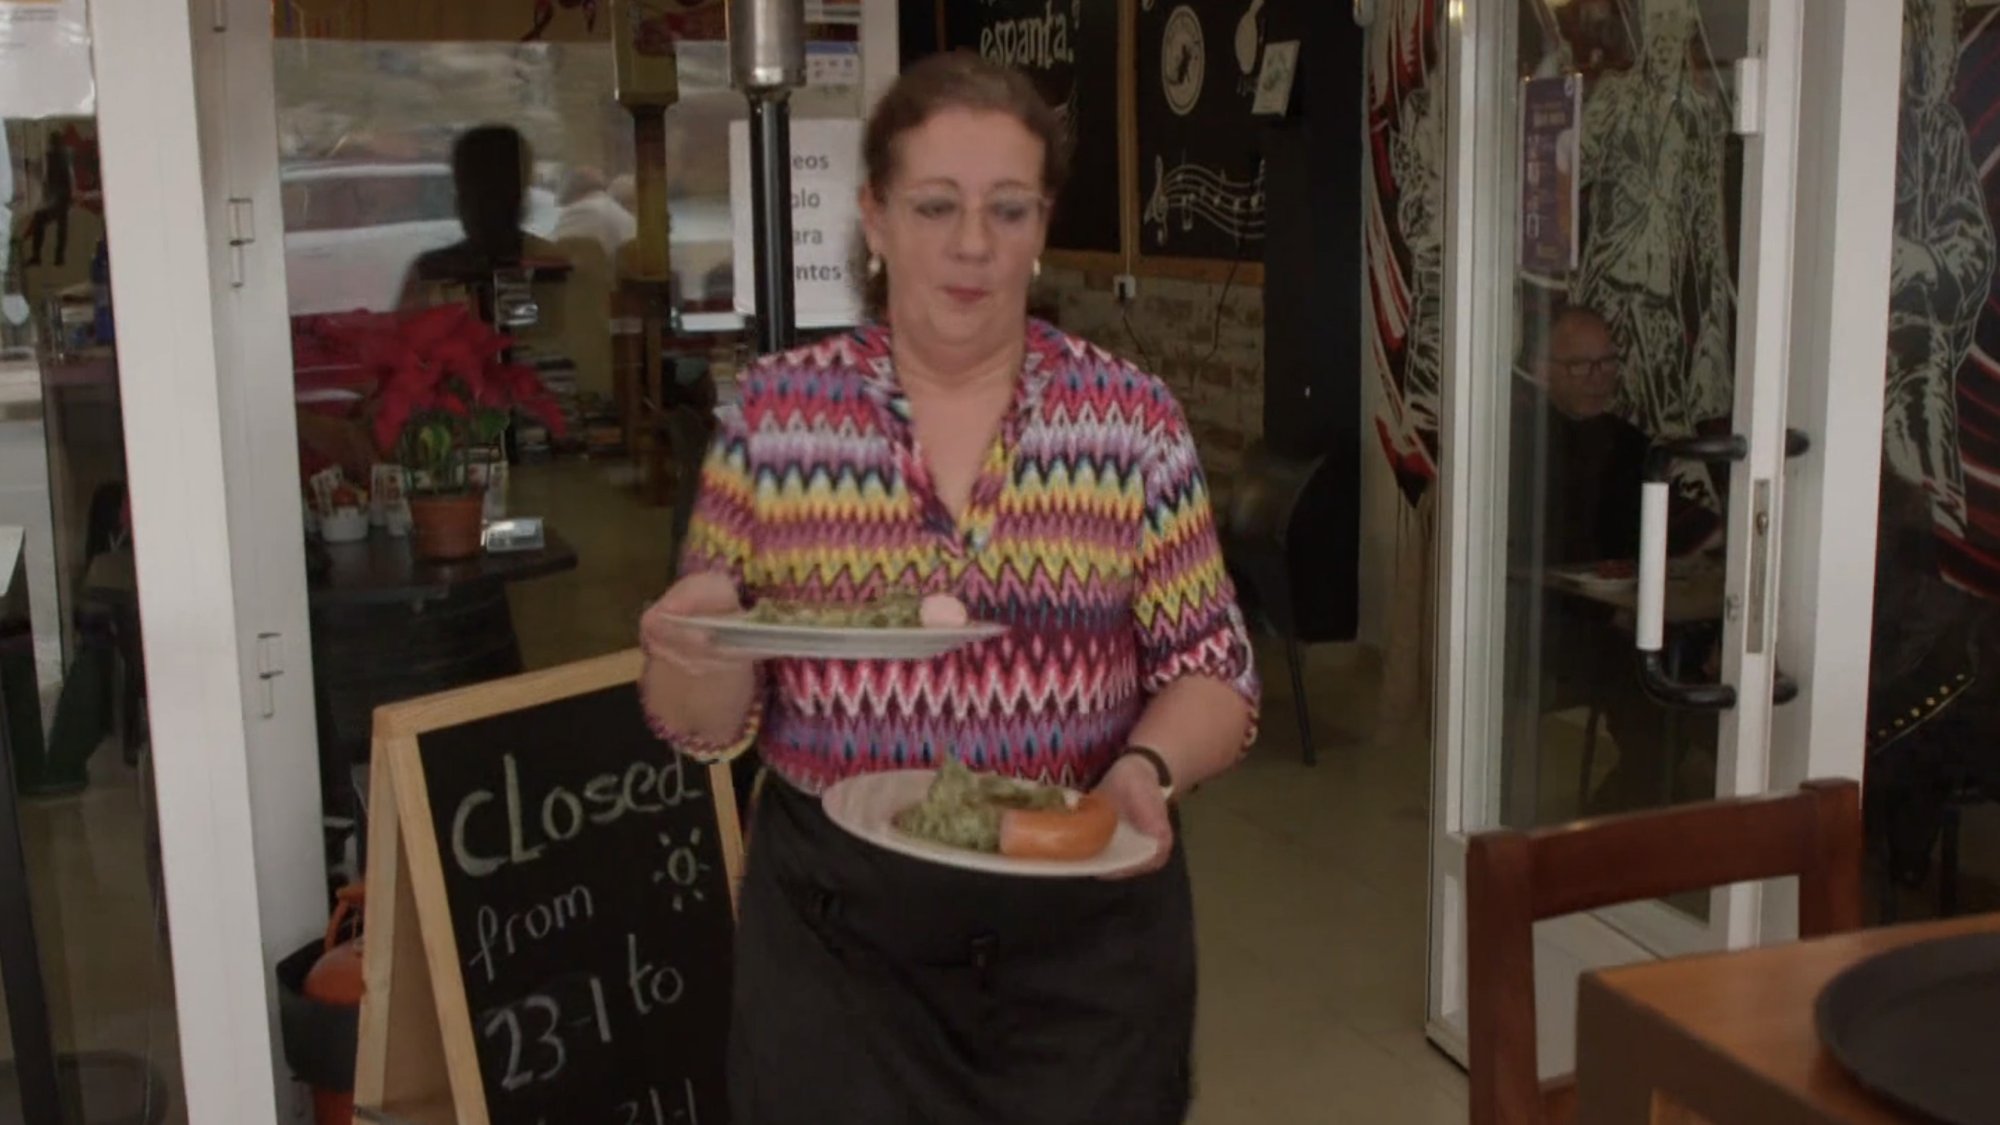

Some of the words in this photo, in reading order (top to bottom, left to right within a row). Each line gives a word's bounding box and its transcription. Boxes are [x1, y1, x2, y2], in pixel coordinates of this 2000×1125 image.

[792, 153, 830, 170] eos
[791, 187, 821, 209] olo
[792, 227, 823, 244] ara
[795, 264, 842, 281] ntes
[469, 885, 593, 982] from
[627, 933, 683, 1015] to
